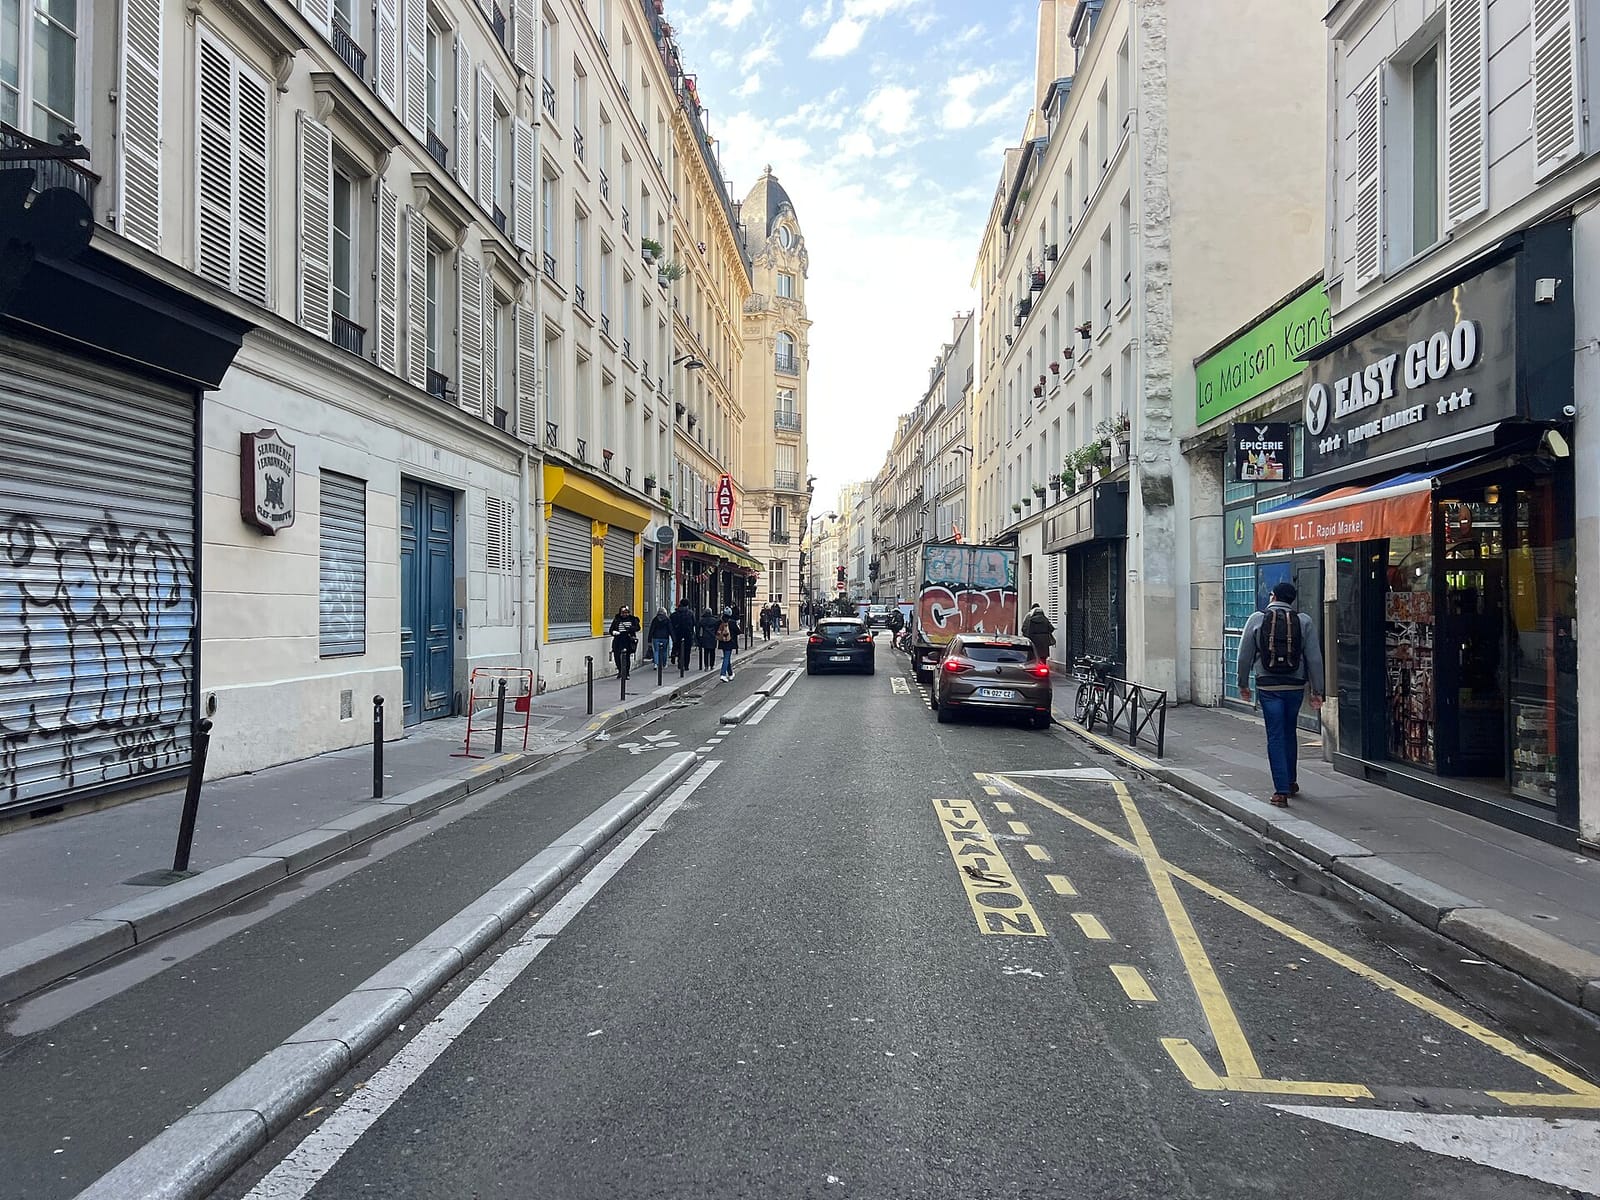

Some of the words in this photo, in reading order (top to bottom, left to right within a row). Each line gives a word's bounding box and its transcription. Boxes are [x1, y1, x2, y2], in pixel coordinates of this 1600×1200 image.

[1199, 380, 1213, 408] La
[1220, 343, 1276, 397] Maison
[1334, 353, 1397, 419] EASY
[1404, 320, 1476, 389] GOO
[1382, 403, 1425, 432] MARKET
[1239, 438, 1284, 450] ÉPICERIE
[720, 477, 731, 524] TABAC
[1293, 521, 1315, 541] T.L.T.
[1316, 522, 1336, 539] Rapid
[1337, 519, 1364, 534] Market
